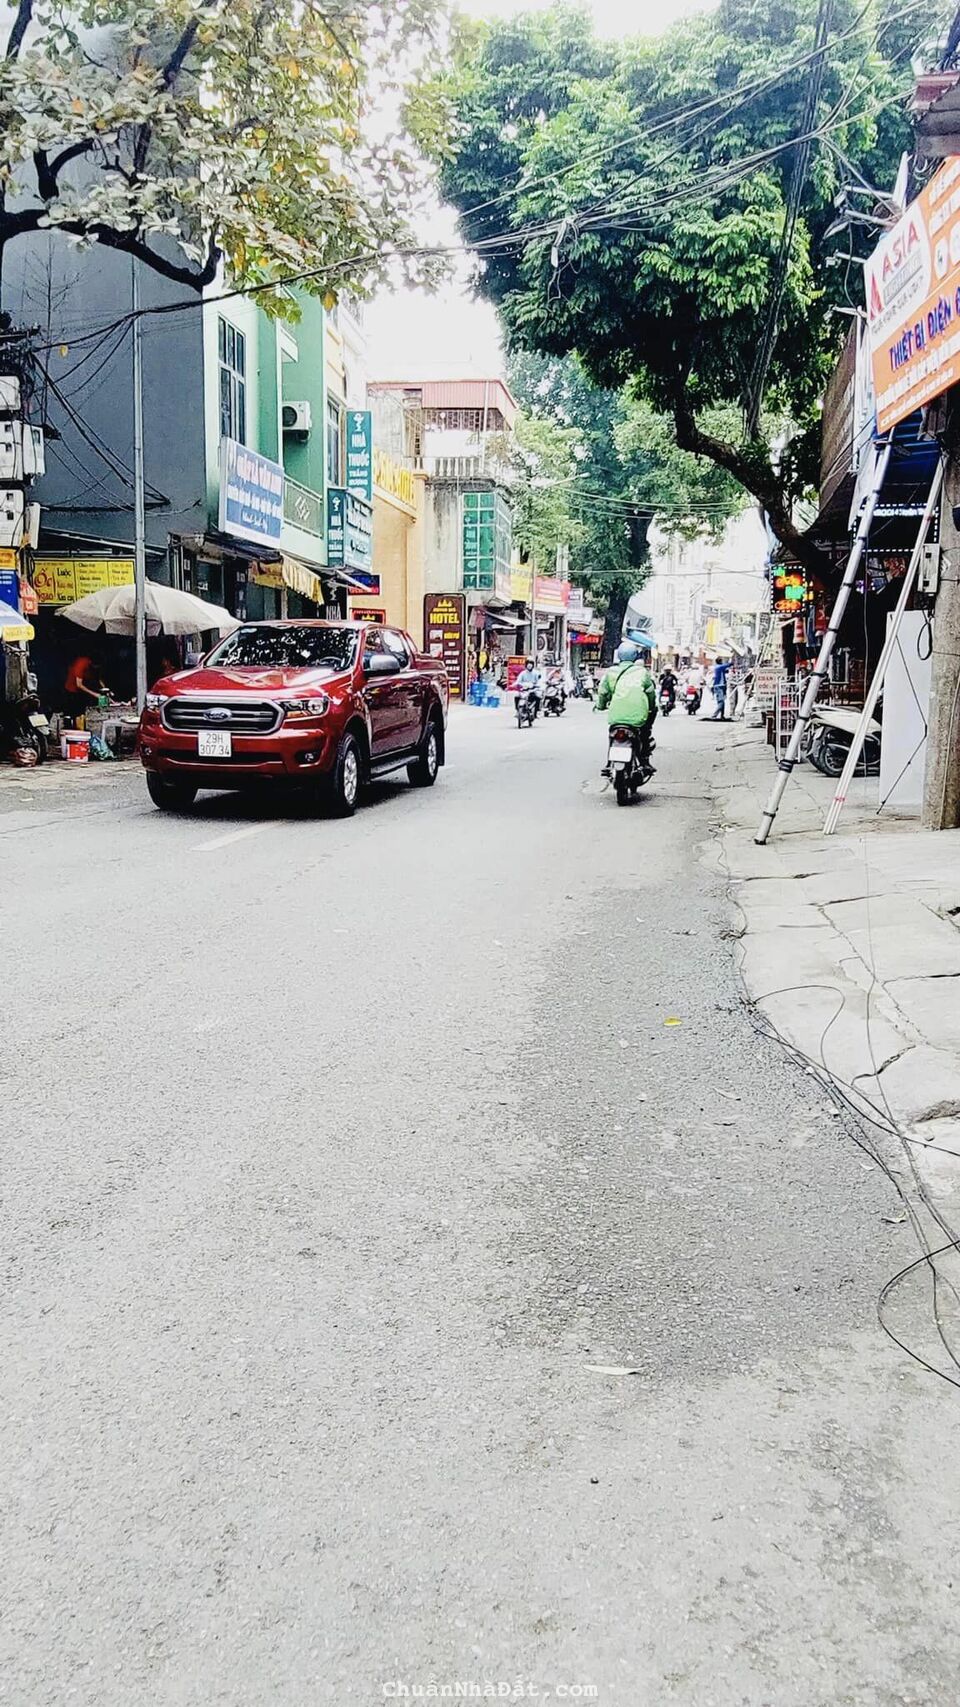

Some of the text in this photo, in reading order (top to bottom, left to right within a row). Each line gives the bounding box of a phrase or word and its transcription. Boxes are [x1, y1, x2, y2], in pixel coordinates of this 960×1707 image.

[883, 221, 920, 281] ASIA
[889, 329, 914, 372] THIẾT
[915, 320, 926, 351] BỊ
[927, 296, 951, 340] ĐIỆN
[430, 612, 460, 624] HOTEL
[206, 733, 224, 744] 29H
